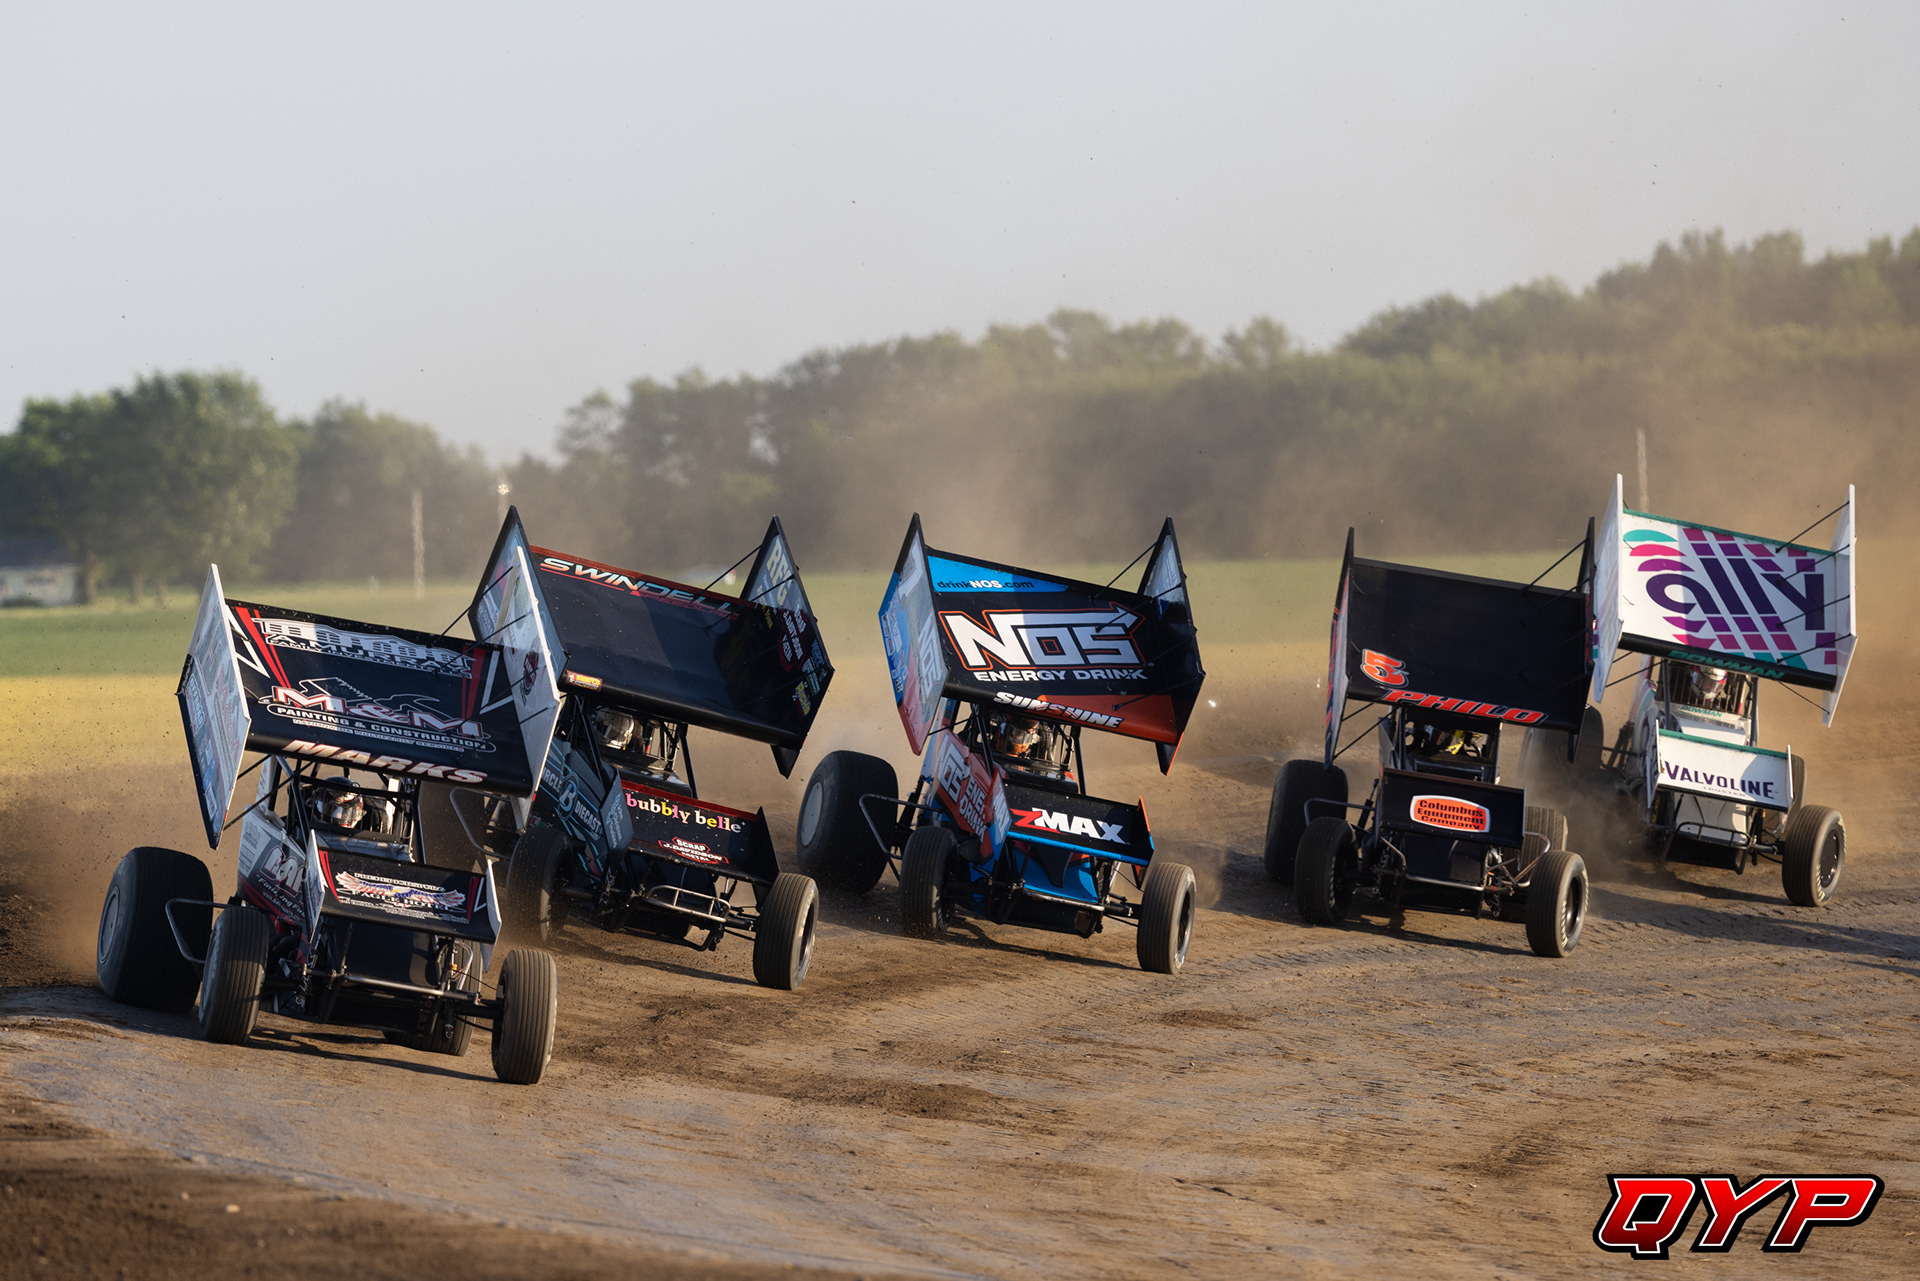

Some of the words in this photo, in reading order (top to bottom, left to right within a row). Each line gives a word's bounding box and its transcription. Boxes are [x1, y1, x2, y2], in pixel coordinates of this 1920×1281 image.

[540, 557, 740, 615] SWINDELL
[936, 578, 1035, 591] drinkNOS.com
[944, 607, 1141, 666] NOS
[974, 669, 1067, 682] ENERGY
[1071, 668, 1149, 681] DRINK
[1361, 649, 1408, 688] 5
[1668, 650, 1785, 679] BOWMAN
[993, 691, 1125, 729] SUNSHINE
[1384, 688, 1548, 724] PHILO
[1680, 705, 1724, 718] BOWMAN
[277, 707, 350, 726] PAINTING
[370, 723, 486, 749] CONSTRUCTION
[281, 739, 488, 783] MARKS
[541, 766, 562, 793] IRCLE
[1664, 760, 1775, 799] VALVOLINE
[574, 800, 602, 834] DIECAST
[625, 793, 691, 824] bubbly
[695, 810, 741, 833] belle
[1417, 808, 1484, 824] Equipment
[1419, 800, 1483, 817] Columbus
[1421, 815, 1480, 829] Company
[663, 844, 722, 860] J.DAVIDSON
[676, 839, 706, 851] SCRAP
[351, 889, 400, 903] EAGLE
[403, 897, 453, 911] HOTEL
